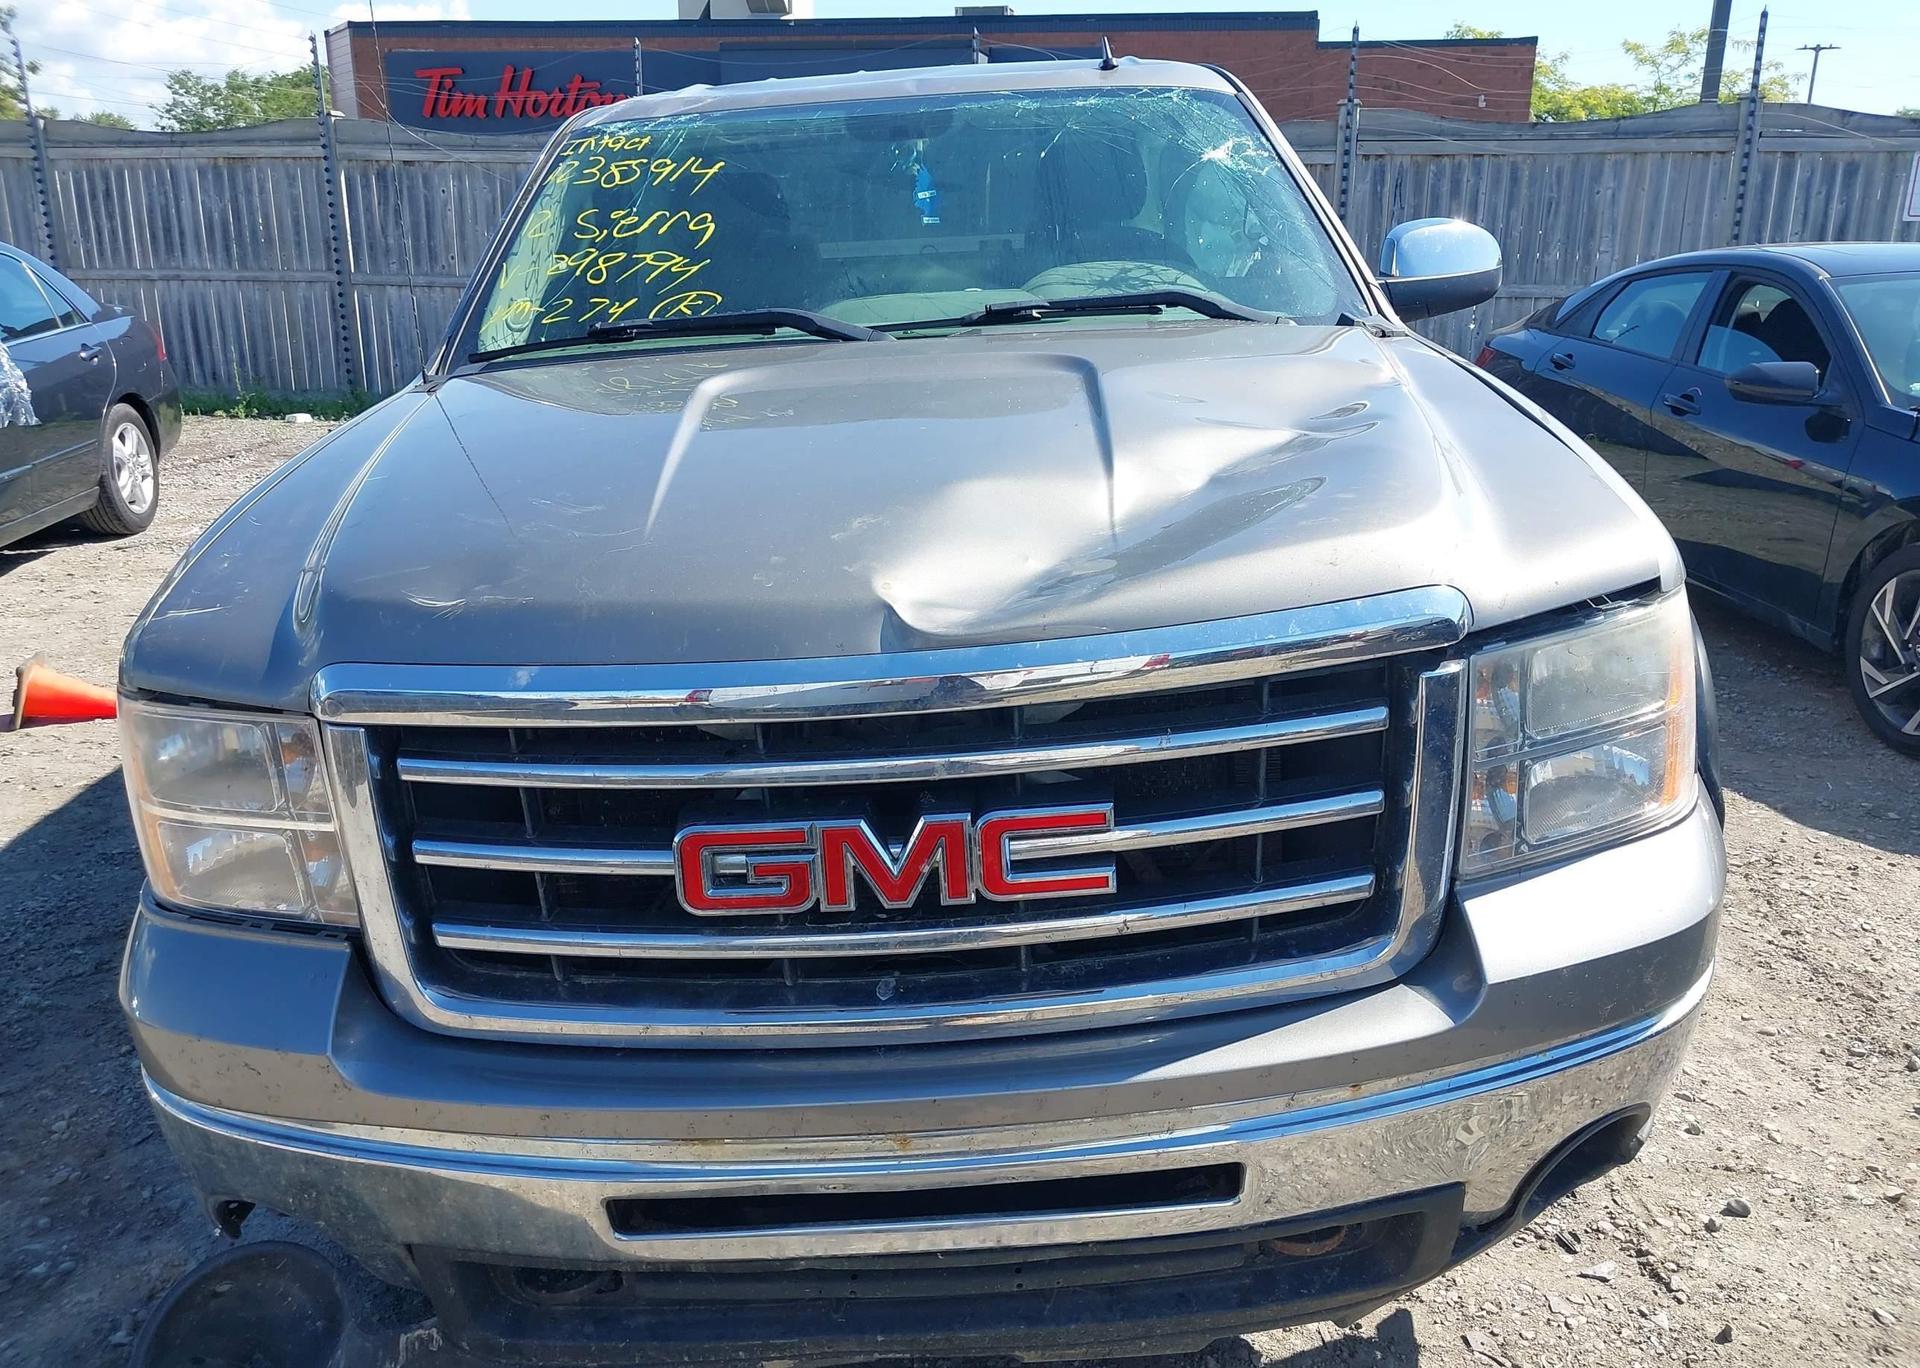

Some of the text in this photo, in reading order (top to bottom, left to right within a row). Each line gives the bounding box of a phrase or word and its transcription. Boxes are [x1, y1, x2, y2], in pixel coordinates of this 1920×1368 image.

[415, 67, 489, 119] Tim
[560, 135, 652, 156] Intact
[574, 209, 716, 250] Sierra
[673, 802, 1117, 916] GMC
